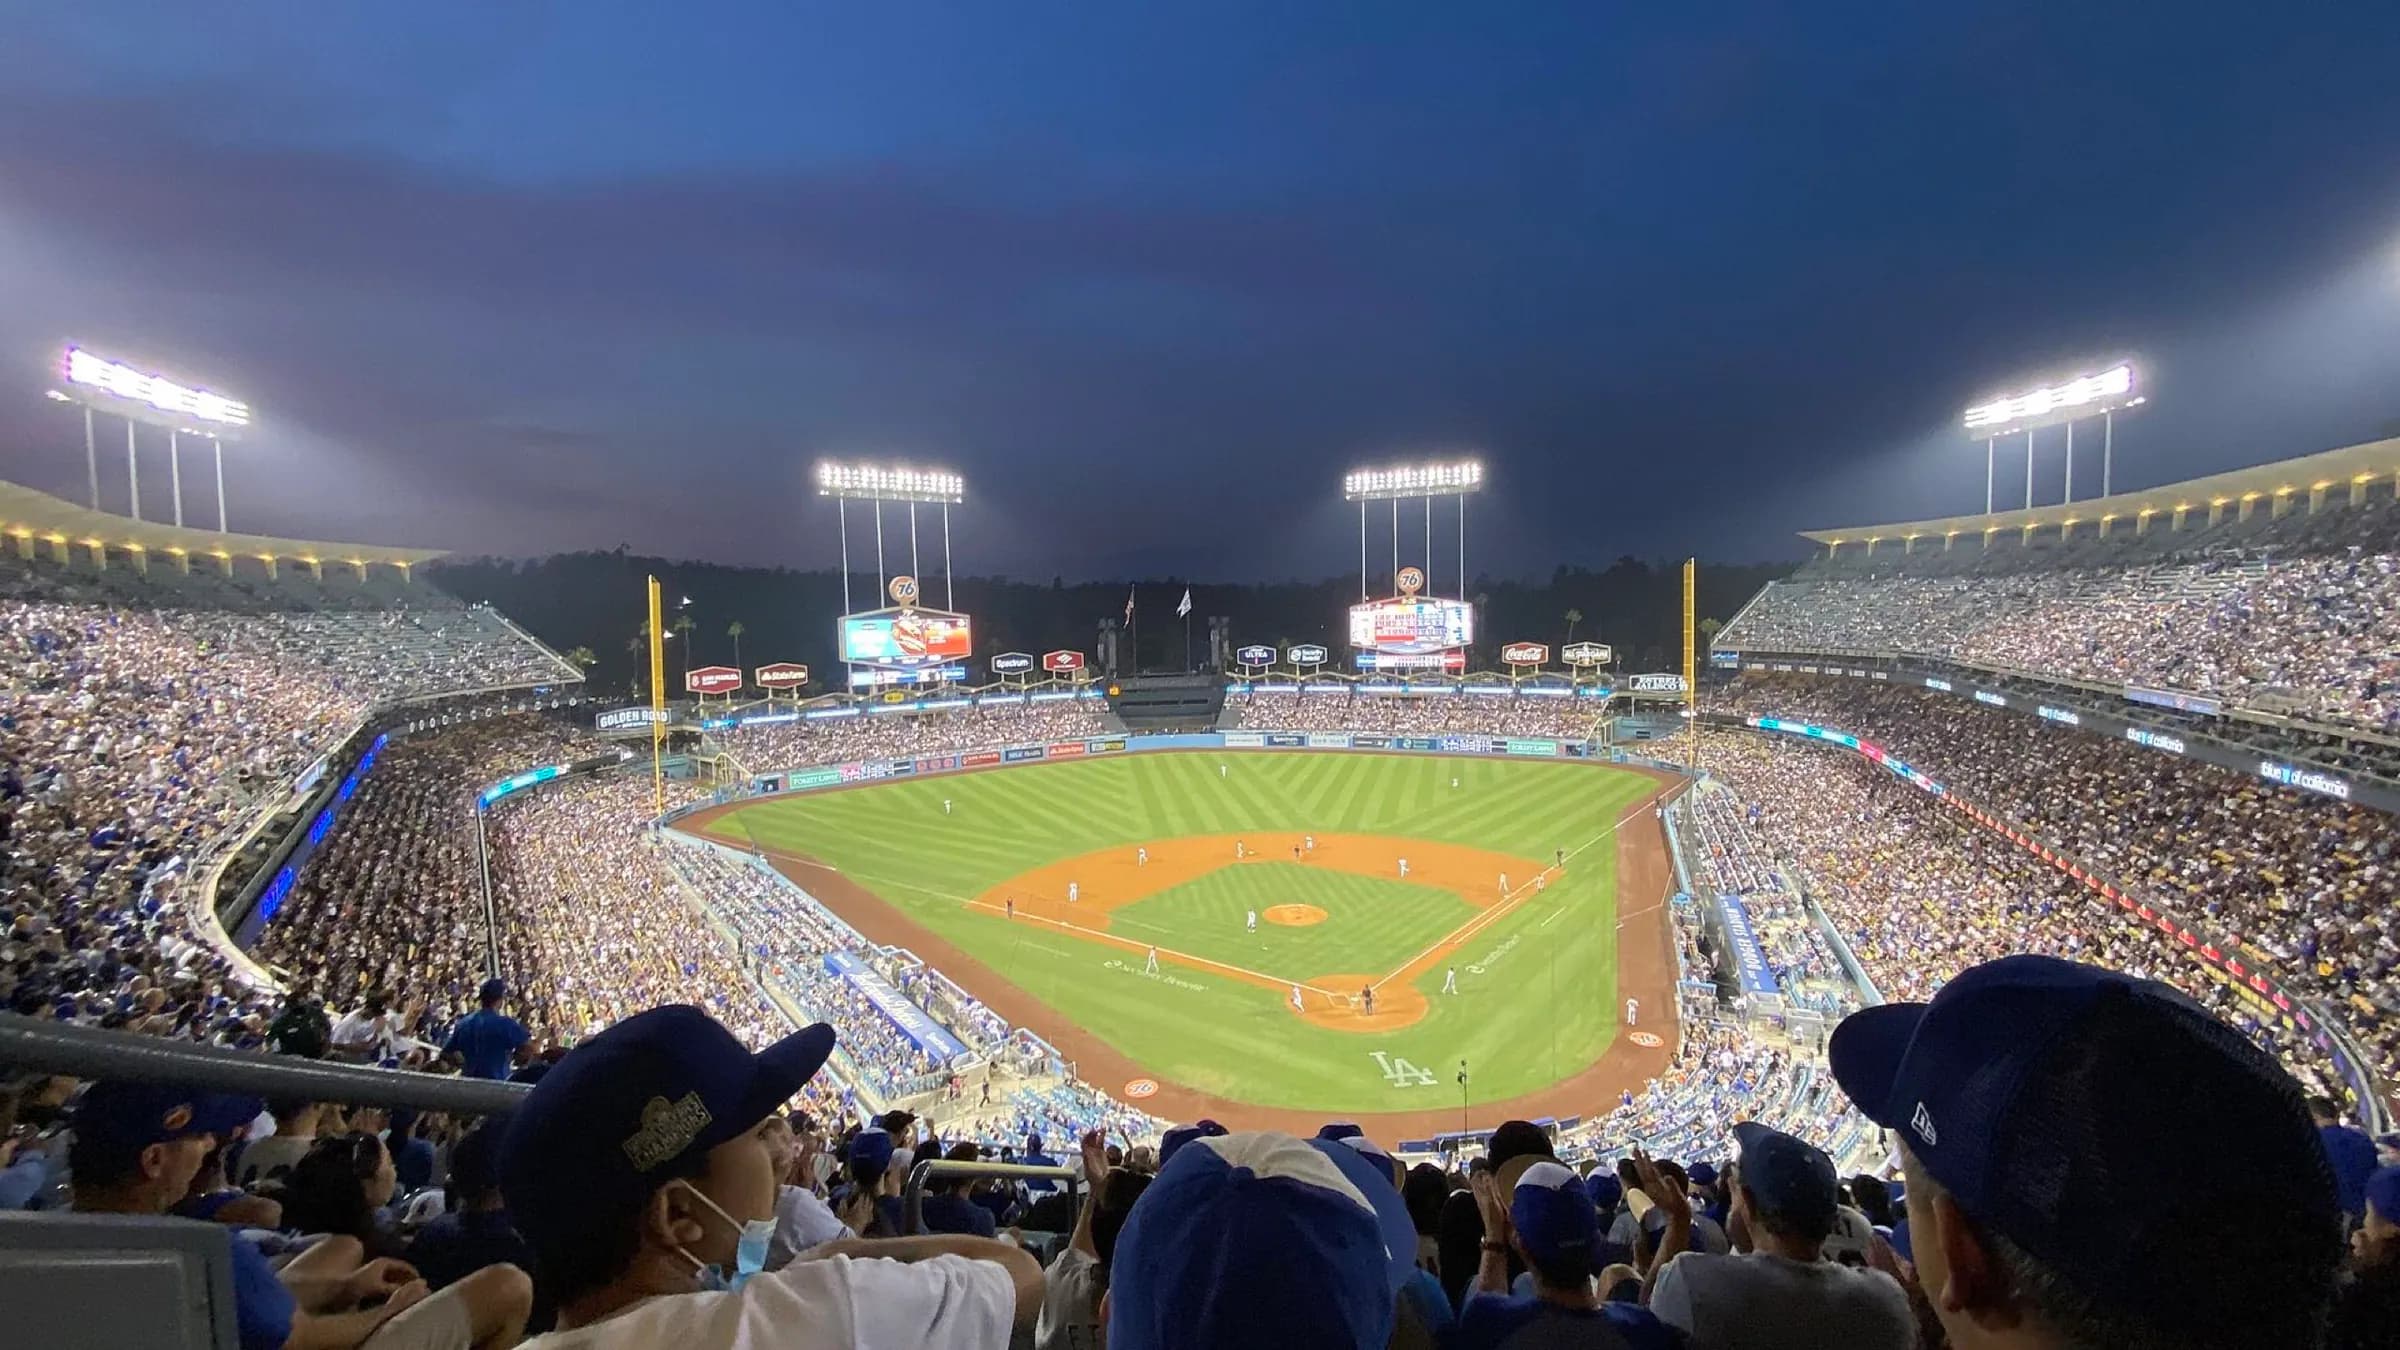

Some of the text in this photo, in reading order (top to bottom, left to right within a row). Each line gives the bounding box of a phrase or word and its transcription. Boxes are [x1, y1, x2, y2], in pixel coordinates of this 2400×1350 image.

[1403, 574, 1419, 586] 76
[898, 582, 914, 597] 76
[1245, 651, 1269, 659] ULTRA
[996, 659, 1030, 669] Spectrum
[600, 711, 641, 728] GOLDEN
[2261, 761, 2350, 799] blue of california
[1725, 907, 1750, 938] STADIUM
[1736, 937, 1764, 971] DODGER
[1368, 1051, 1439, 1087] LA
